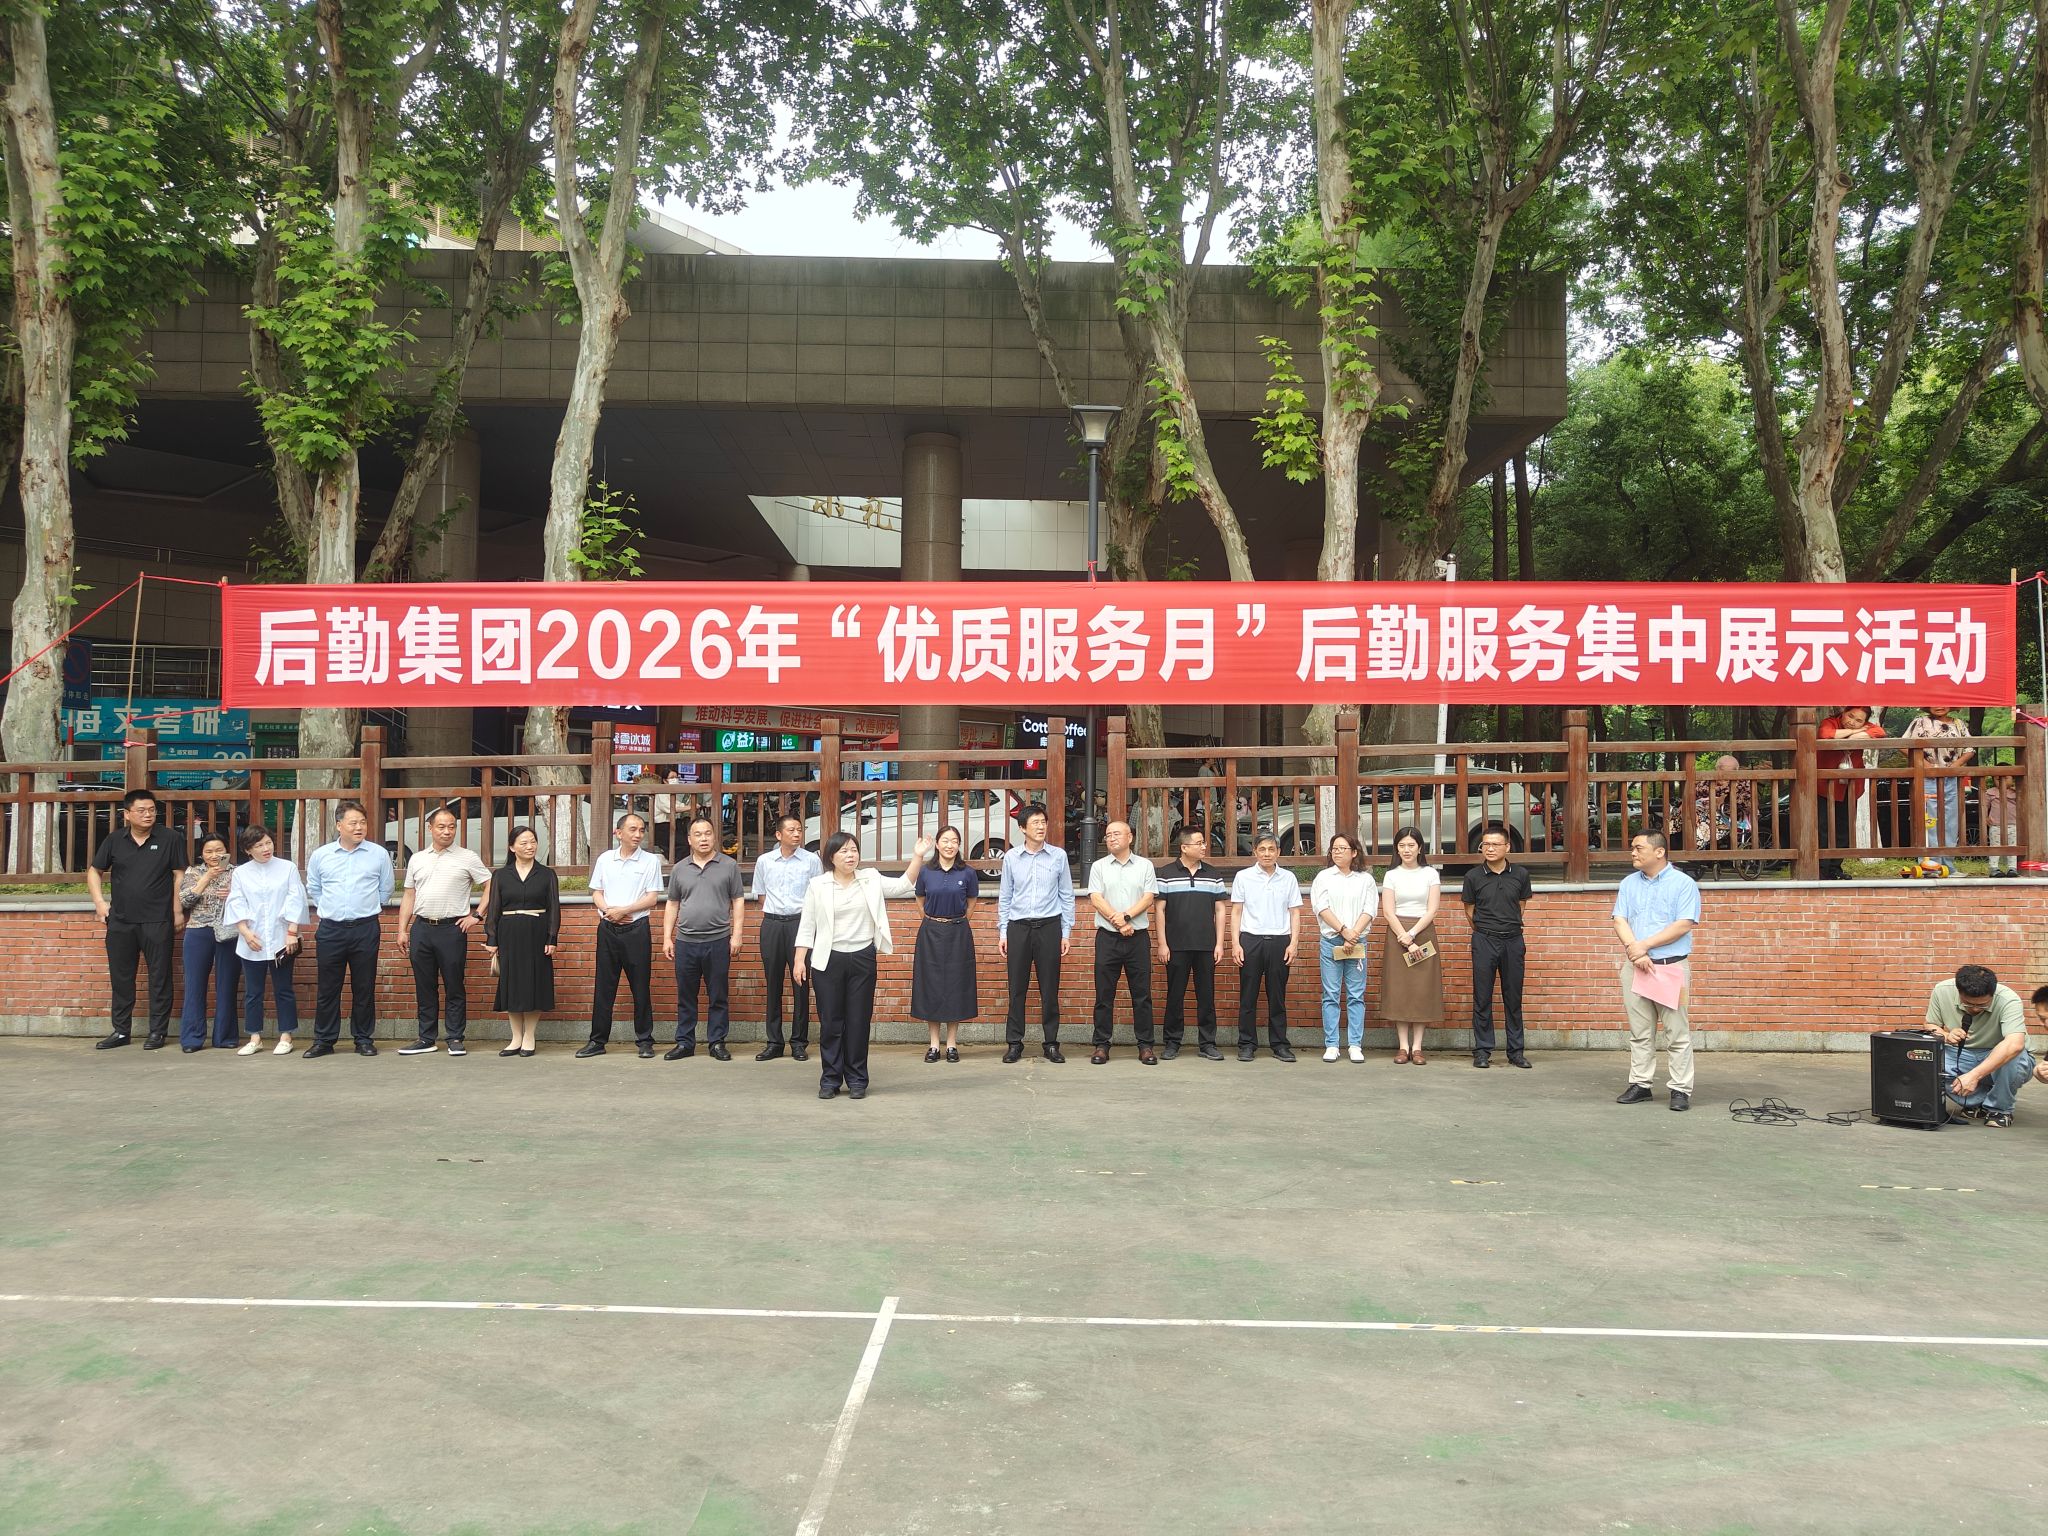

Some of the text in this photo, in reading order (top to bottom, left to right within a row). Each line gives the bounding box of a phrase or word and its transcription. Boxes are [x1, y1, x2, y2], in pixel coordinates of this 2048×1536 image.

[255, 604, 1986, 685] 后勤集团2026年“优质服务月”后勤服务集中展示活动
[1023, 719, 1048, 734] Cott
